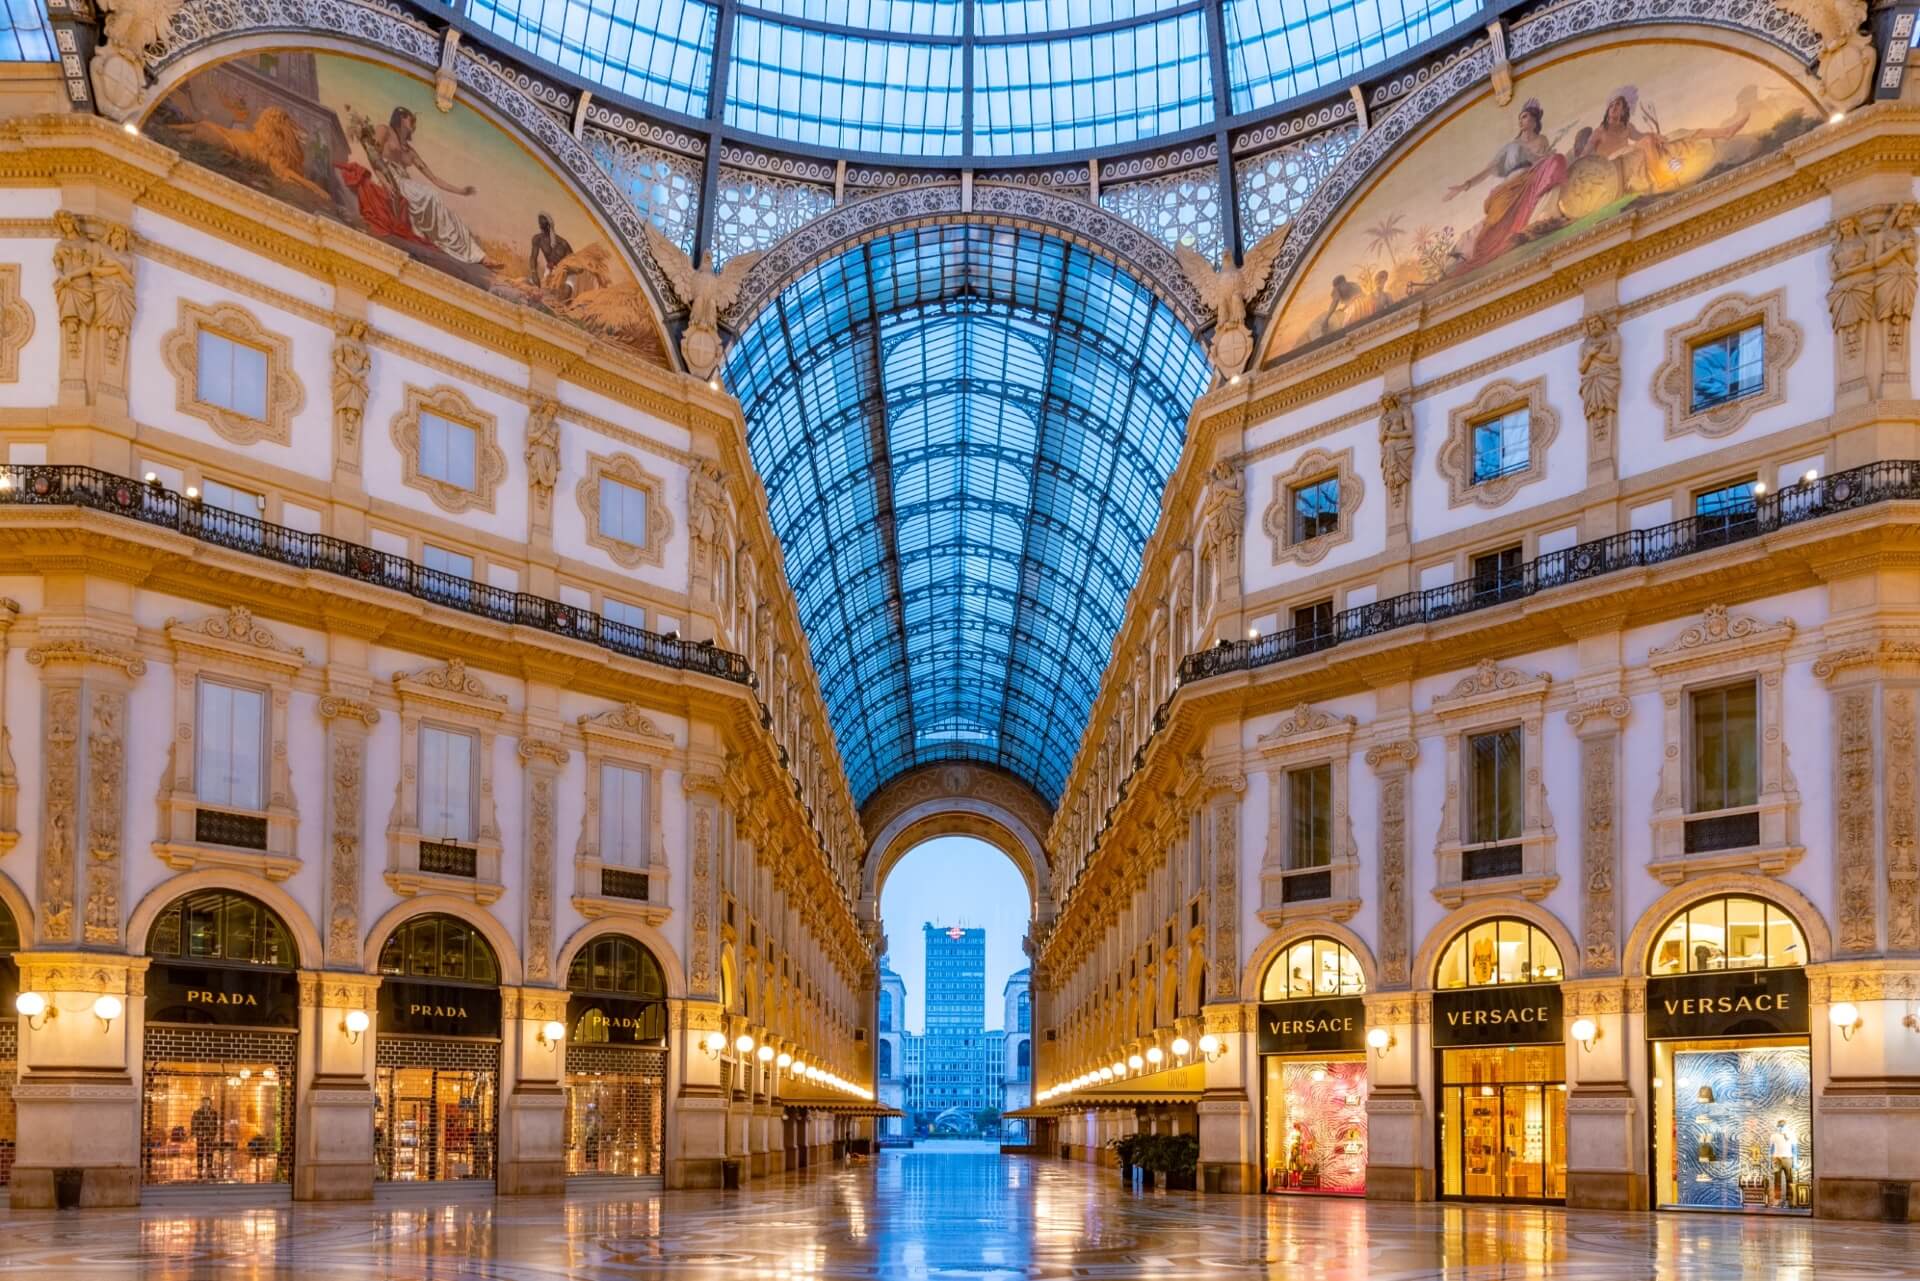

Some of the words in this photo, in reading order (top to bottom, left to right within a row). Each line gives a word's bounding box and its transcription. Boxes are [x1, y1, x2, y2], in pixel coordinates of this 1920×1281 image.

[187, 990, 258, 1006] PRADA
[1664, 993, 1790, 1016] VERSACE
[410, 1004, 469, 1018] PRADA
[1447, 1007, 1549, 1026] VERSACE
[592, 1016, 641, 1029] PRADA
[1269, 1017, 1354, 1035] VERSACE
